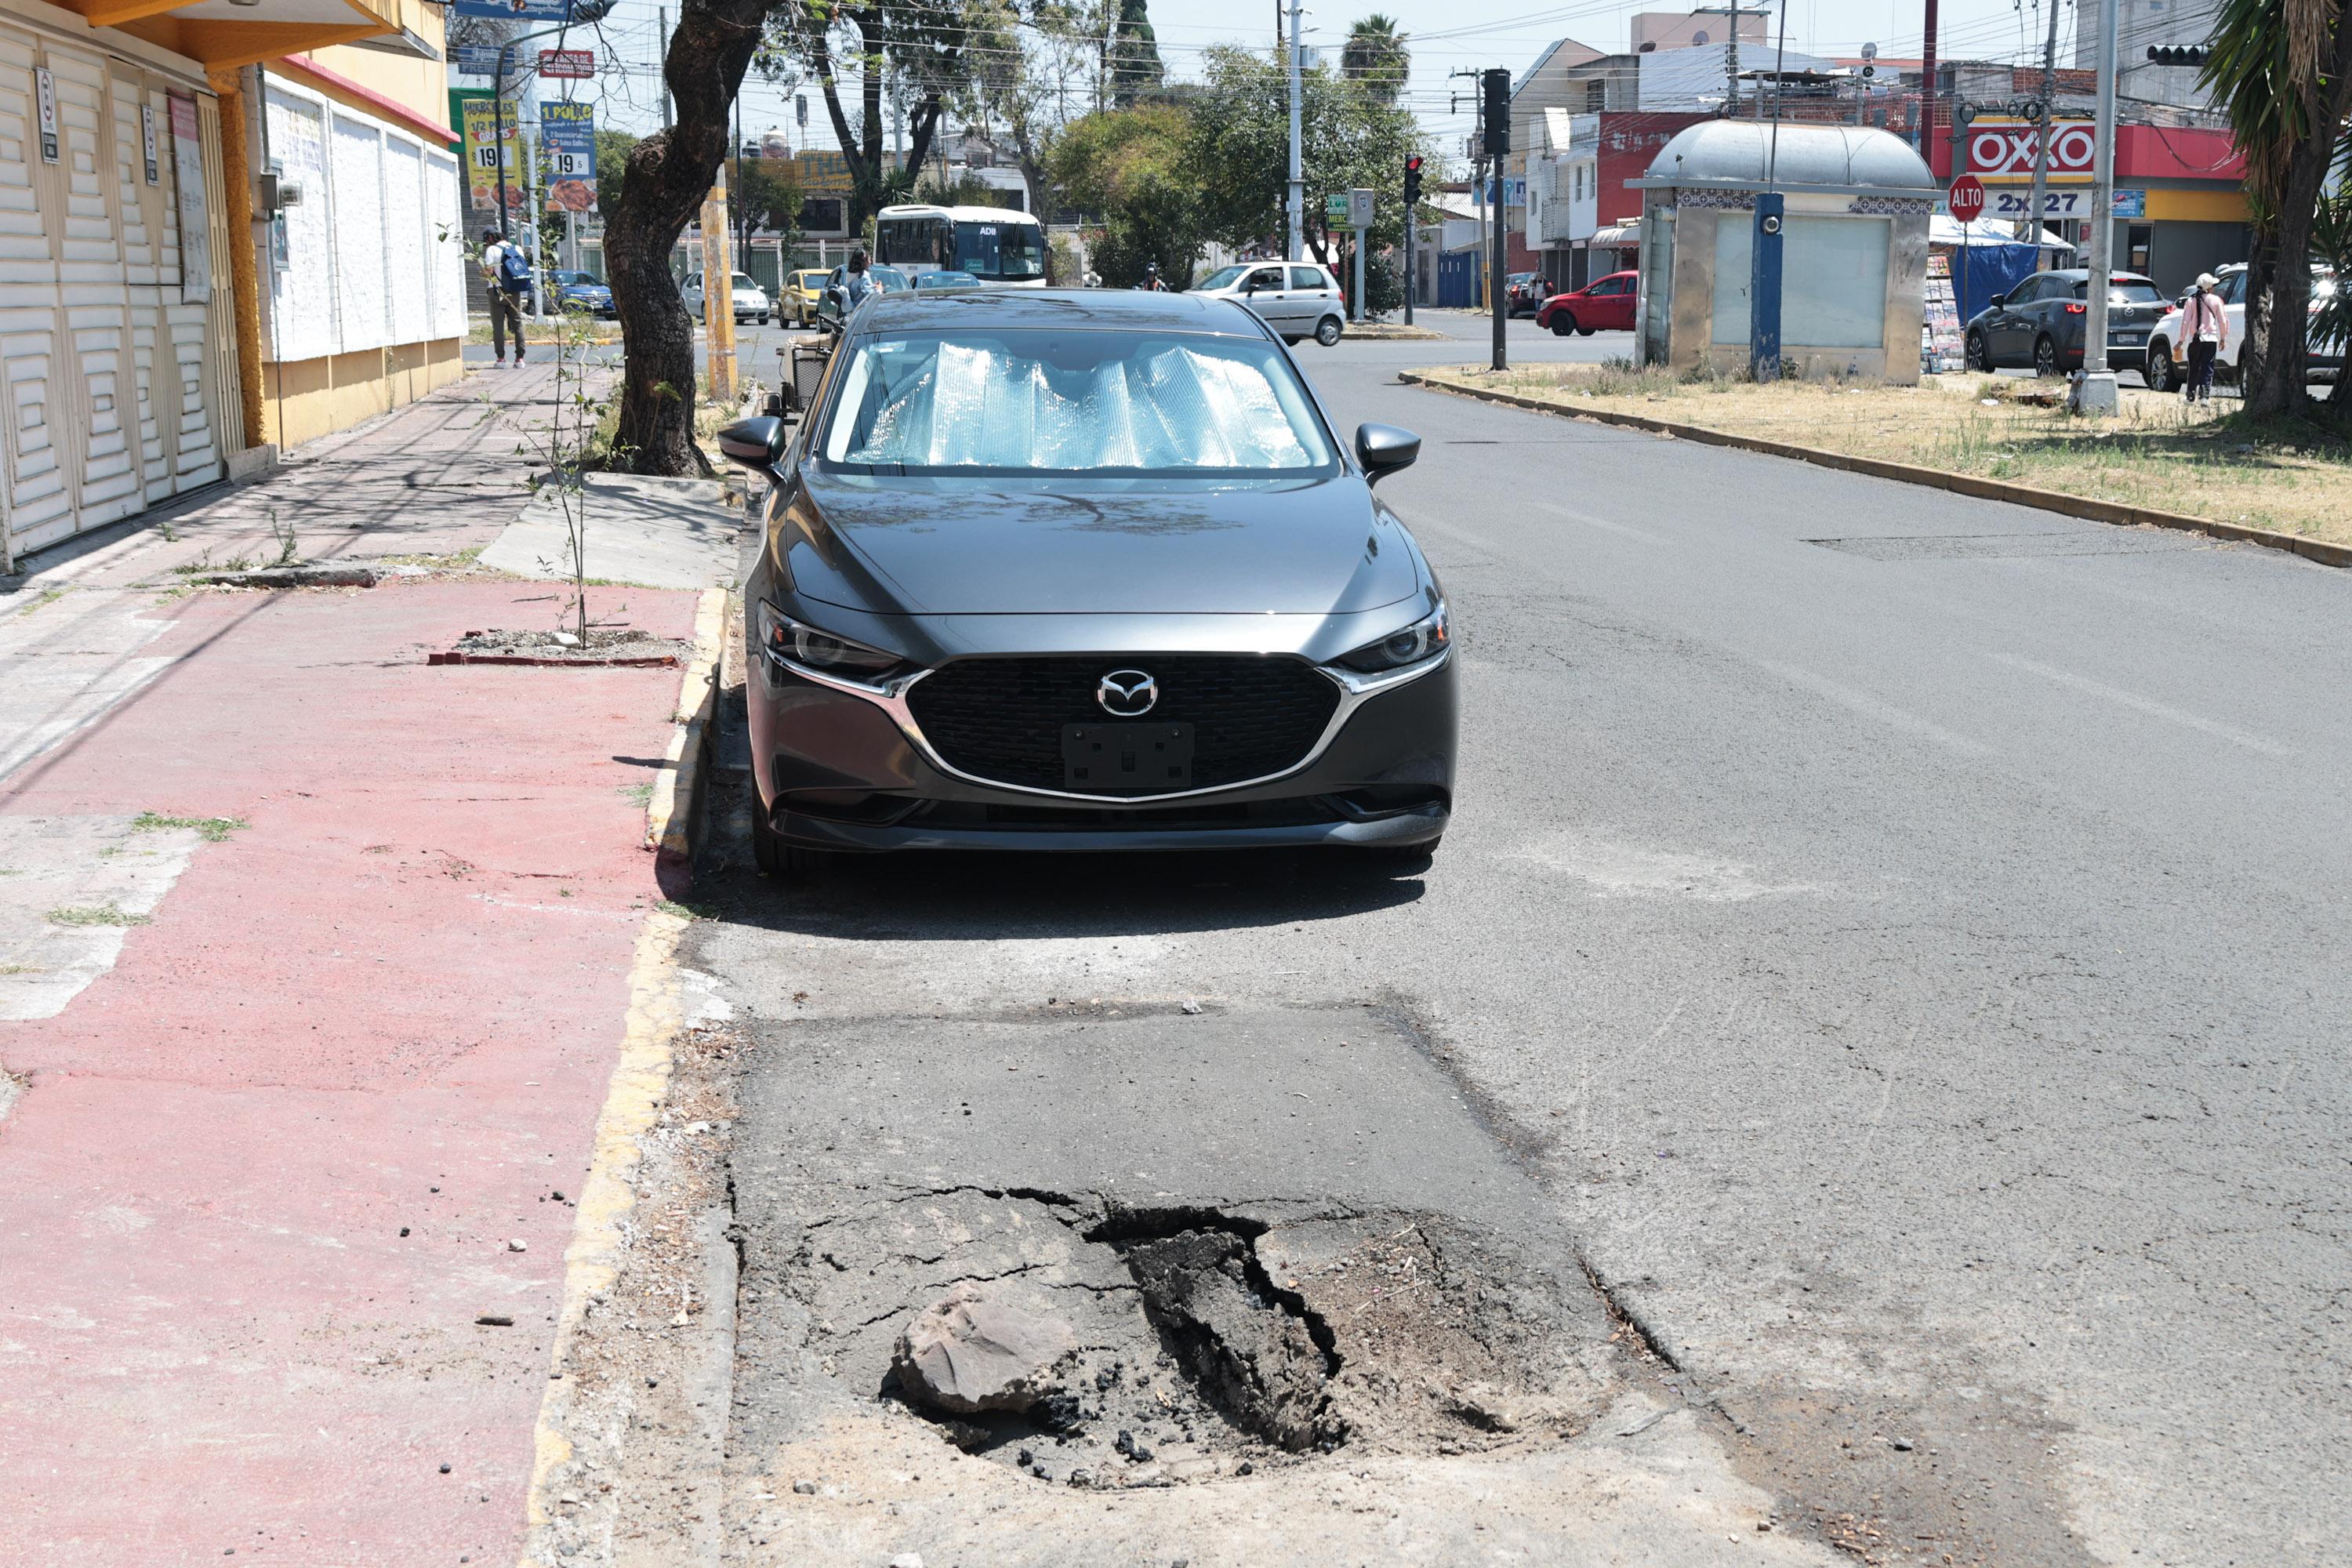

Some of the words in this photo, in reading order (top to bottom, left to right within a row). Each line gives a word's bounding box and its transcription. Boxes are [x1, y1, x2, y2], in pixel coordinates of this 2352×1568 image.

[463, 63, 514, 74] PREMIM
[464, 101, 514, 112] MIERCOES
[553, 105, 593, 121] POLLO
[489, 118, 516, 130] PLLO
[478, 129, 511, 142] GRAIS
[480, 148, 497, 166] 19
[1973, 129, 2095, 169] OXXO
[558, 154, 573, 172] 19
[1952, 188, 1981, 207] ALTO
[2045, 194, 2078, 212] 27
[1329, 215, 1347, 223] MERC
